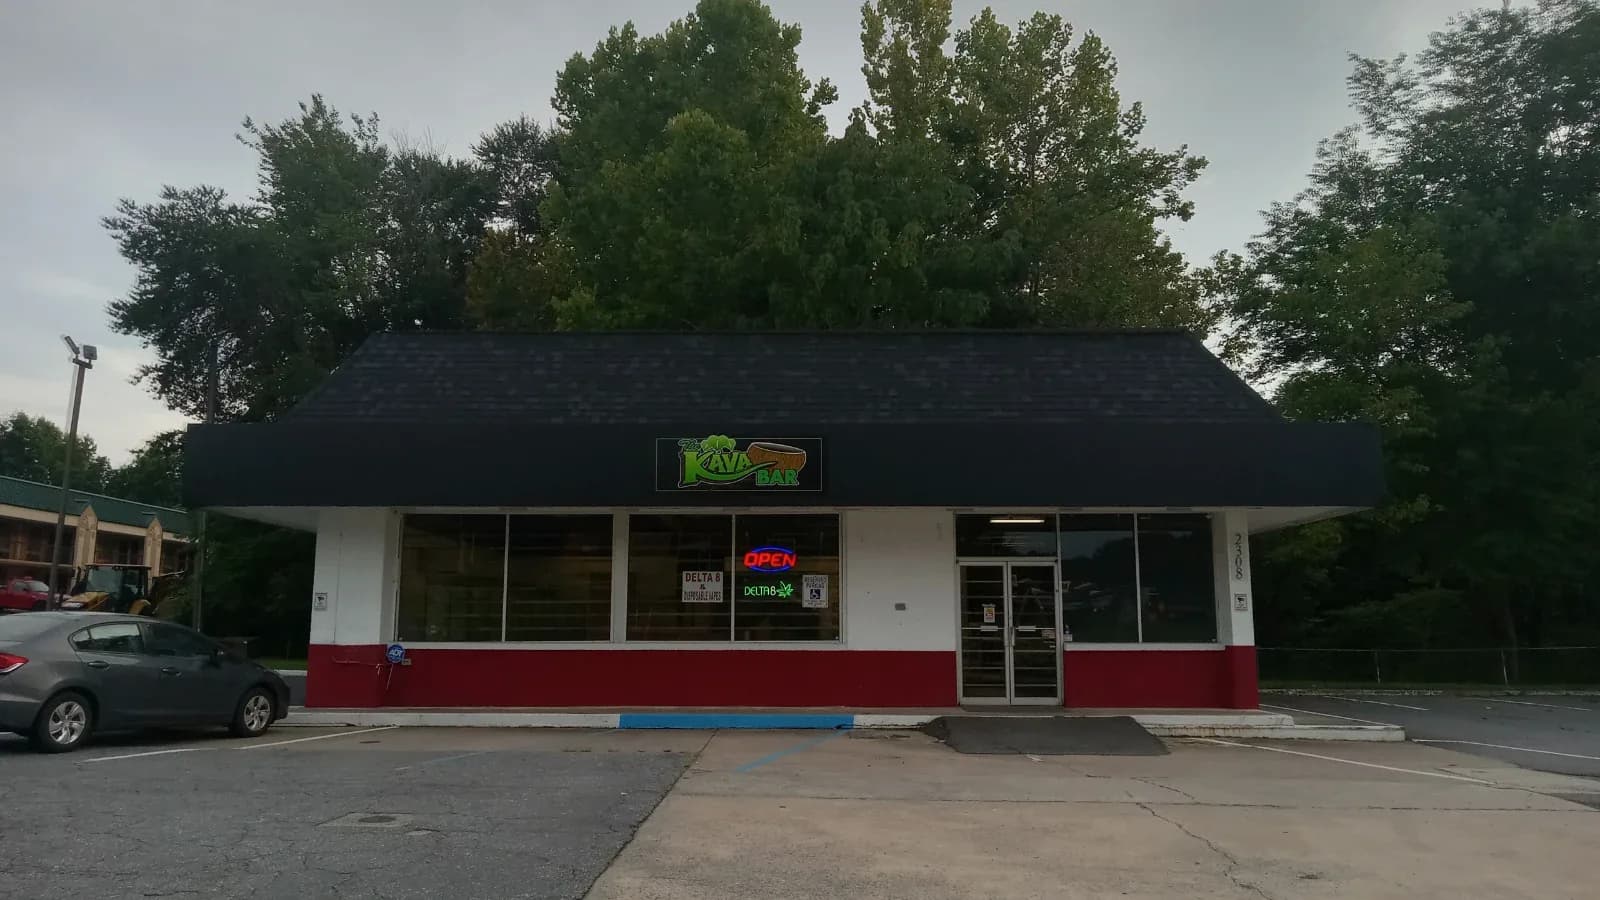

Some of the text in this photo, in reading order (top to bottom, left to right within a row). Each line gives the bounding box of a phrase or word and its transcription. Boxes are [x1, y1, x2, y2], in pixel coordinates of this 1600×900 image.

[682, 450, 760, 485] KAVA
[757, 469, 798, 485] BAR
[743, 552, 797, 567] OPEN
[1233, 533, 1244, 580] 2308
[685, 572, 721, 582] DELTA 8
